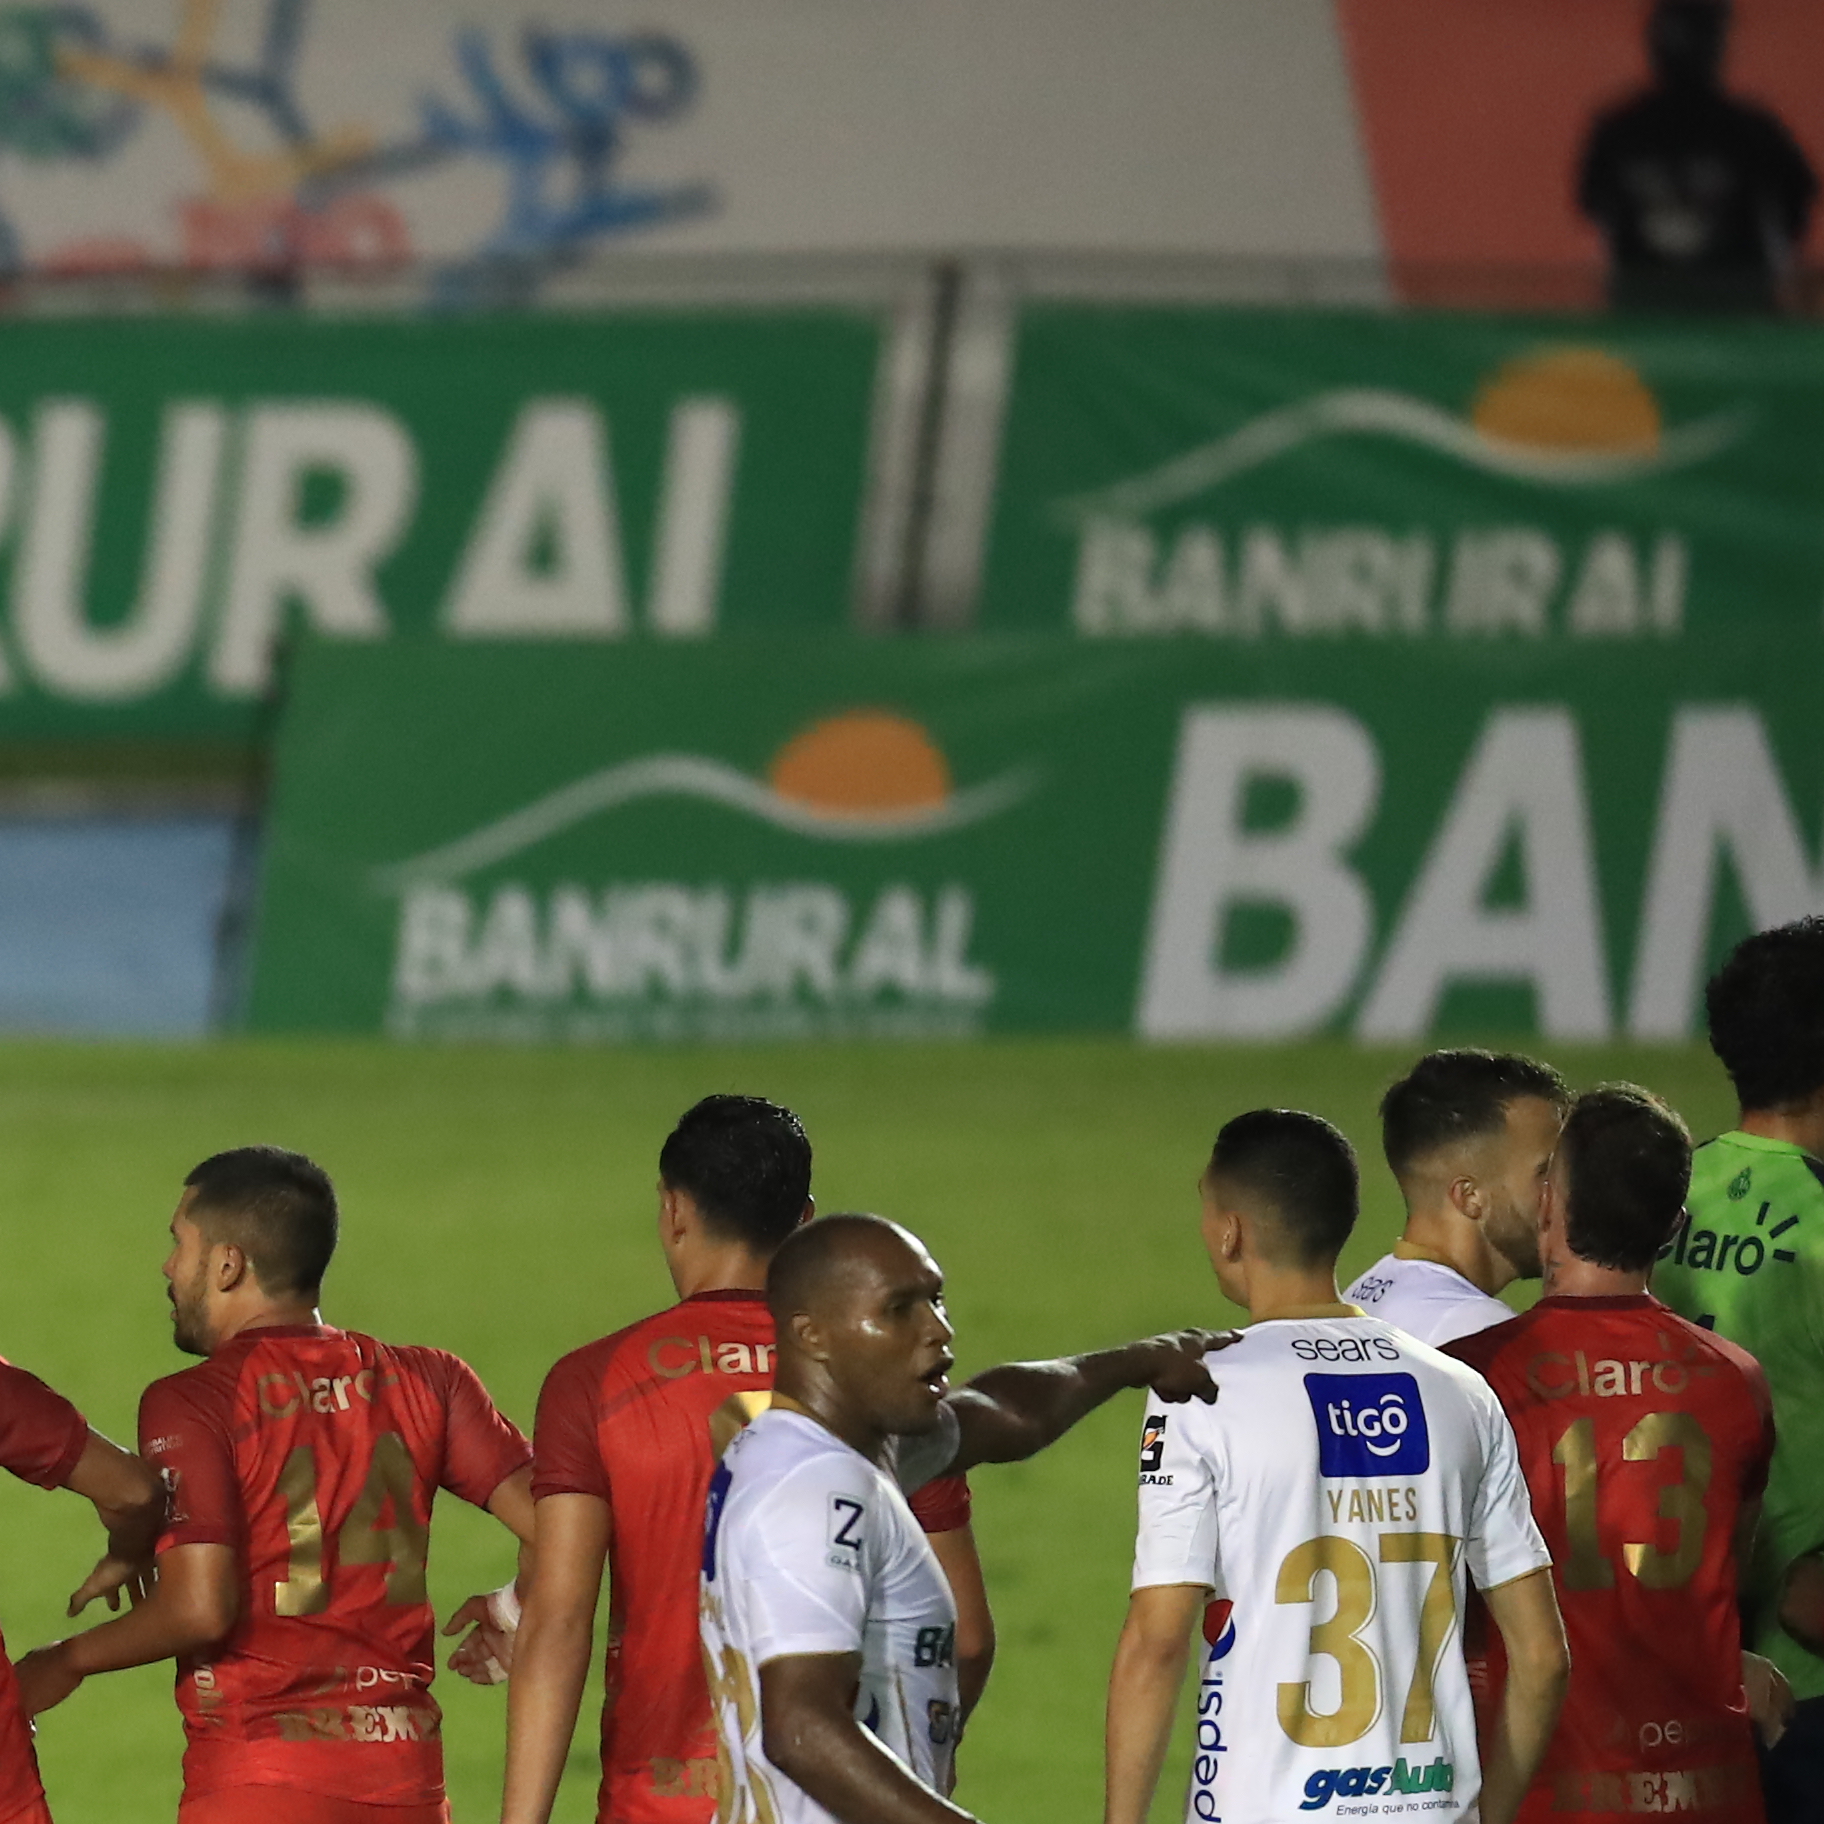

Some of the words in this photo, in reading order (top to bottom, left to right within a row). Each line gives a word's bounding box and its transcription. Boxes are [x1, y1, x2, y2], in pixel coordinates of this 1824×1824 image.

[396, 884, 996, 1000] BANRURAL
[1656, 1215, 1765, 1276] laro
[648, 1335, 777, 1380] Clar
[1291, 1338, 1401, 1362] sears
[1526, 1350, 1690, 1400] Claro
[1327, 1394, 1409, 1442] tigo
[274, 1430, 430, 1617] 14
[1327, 1486, 1418, 1524] YANES
[1552, 1412, 1712, 1591] 13
[1274, 1532, 1466, 1748] 37
[1194, 1679, 1228, 1824] pepsi
[1298, 1756, 1455, 1811] gasAuto
[1382, 1804, 1404, 1815] que
[1407, 1803, 1420, 1812] no
